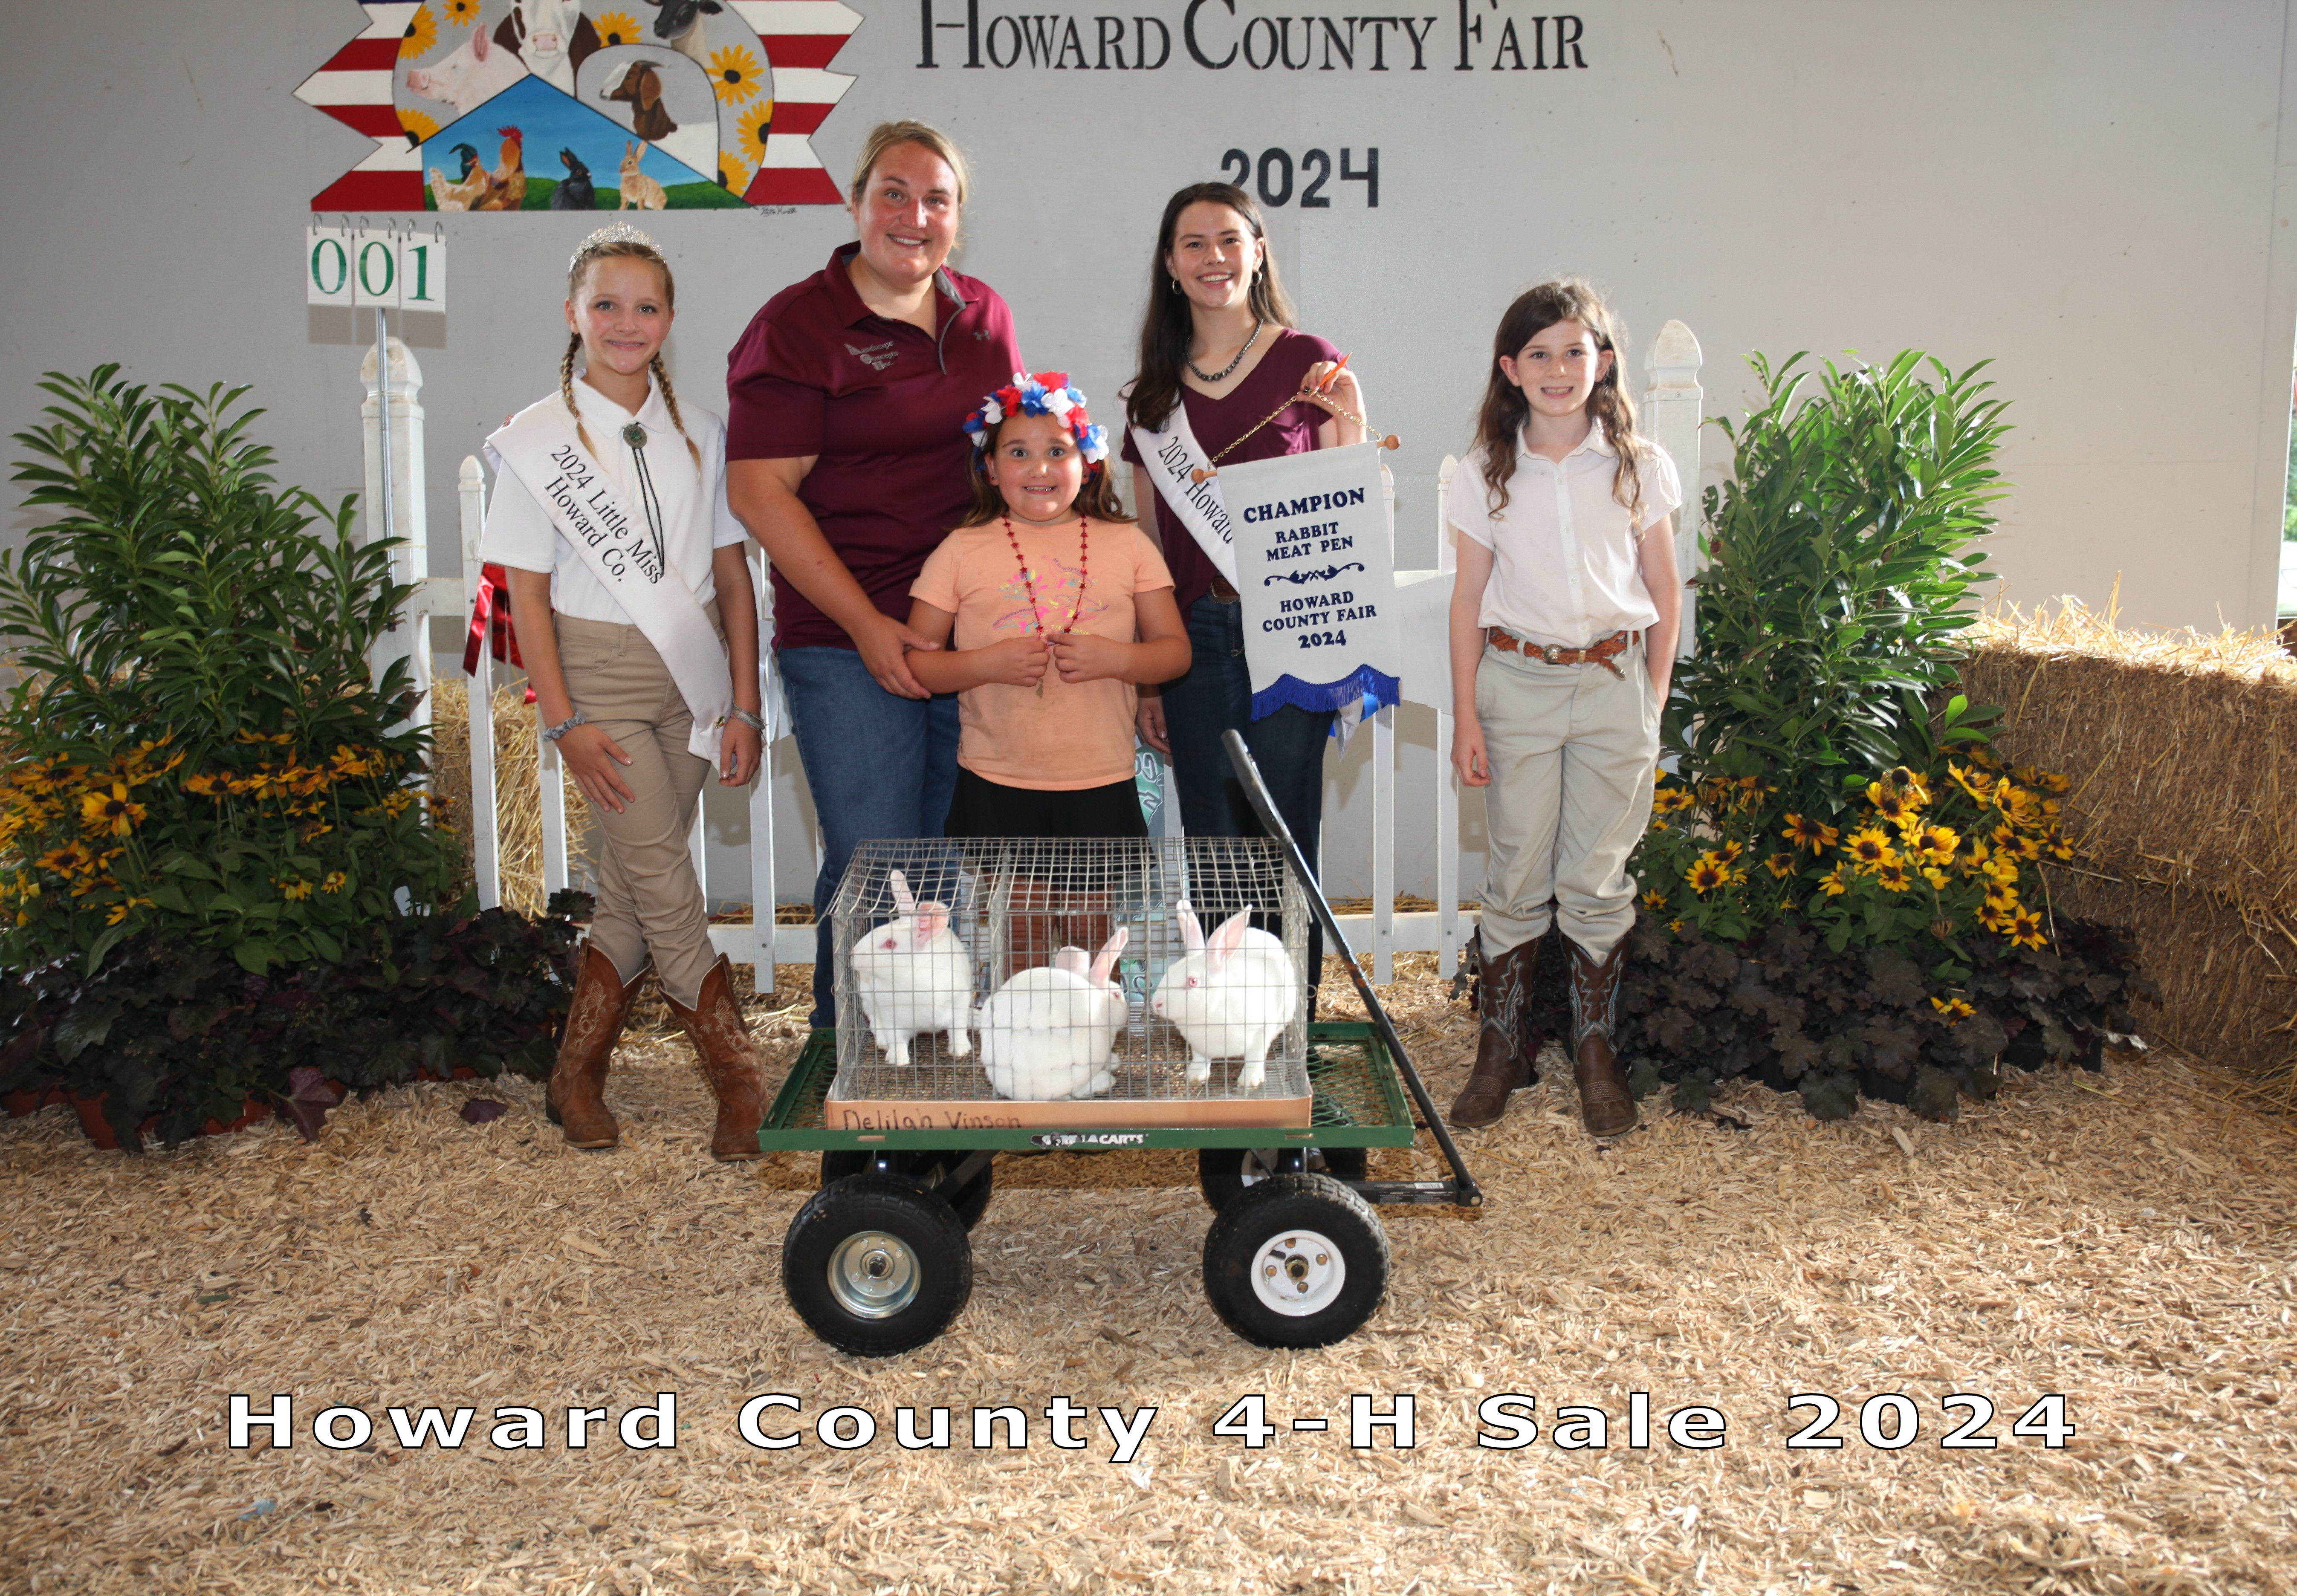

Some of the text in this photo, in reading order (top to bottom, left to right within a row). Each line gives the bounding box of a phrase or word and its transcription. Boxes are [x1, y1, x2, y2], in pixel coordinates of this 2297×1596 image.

[916, 0, 1171, 70] HOWARD
[1183, 0, 1438, 71] COUNTY
[1221, 147, 1379, 208] 2024
[311, 239, 435, 301] 001
[1157, 436, 1195, 483] 2024
[550, 445, 664, 585] 2024 Little Miss
[1243, 487, 1365, 524] CHAMPION
[544, 475, 627, 583] Howard Co.
[1274, 521, 1339, 544] RABBIT
[1265, 536, 1353, 562] MEAT PEN
[1262, 604, 1377, 633] COUNTY FAIR
[1279, 591, 1354, 613] HOWARD
[1297, 629, 1347, 649] 2024
[944, 1110, 1022, 1130] Vinson
